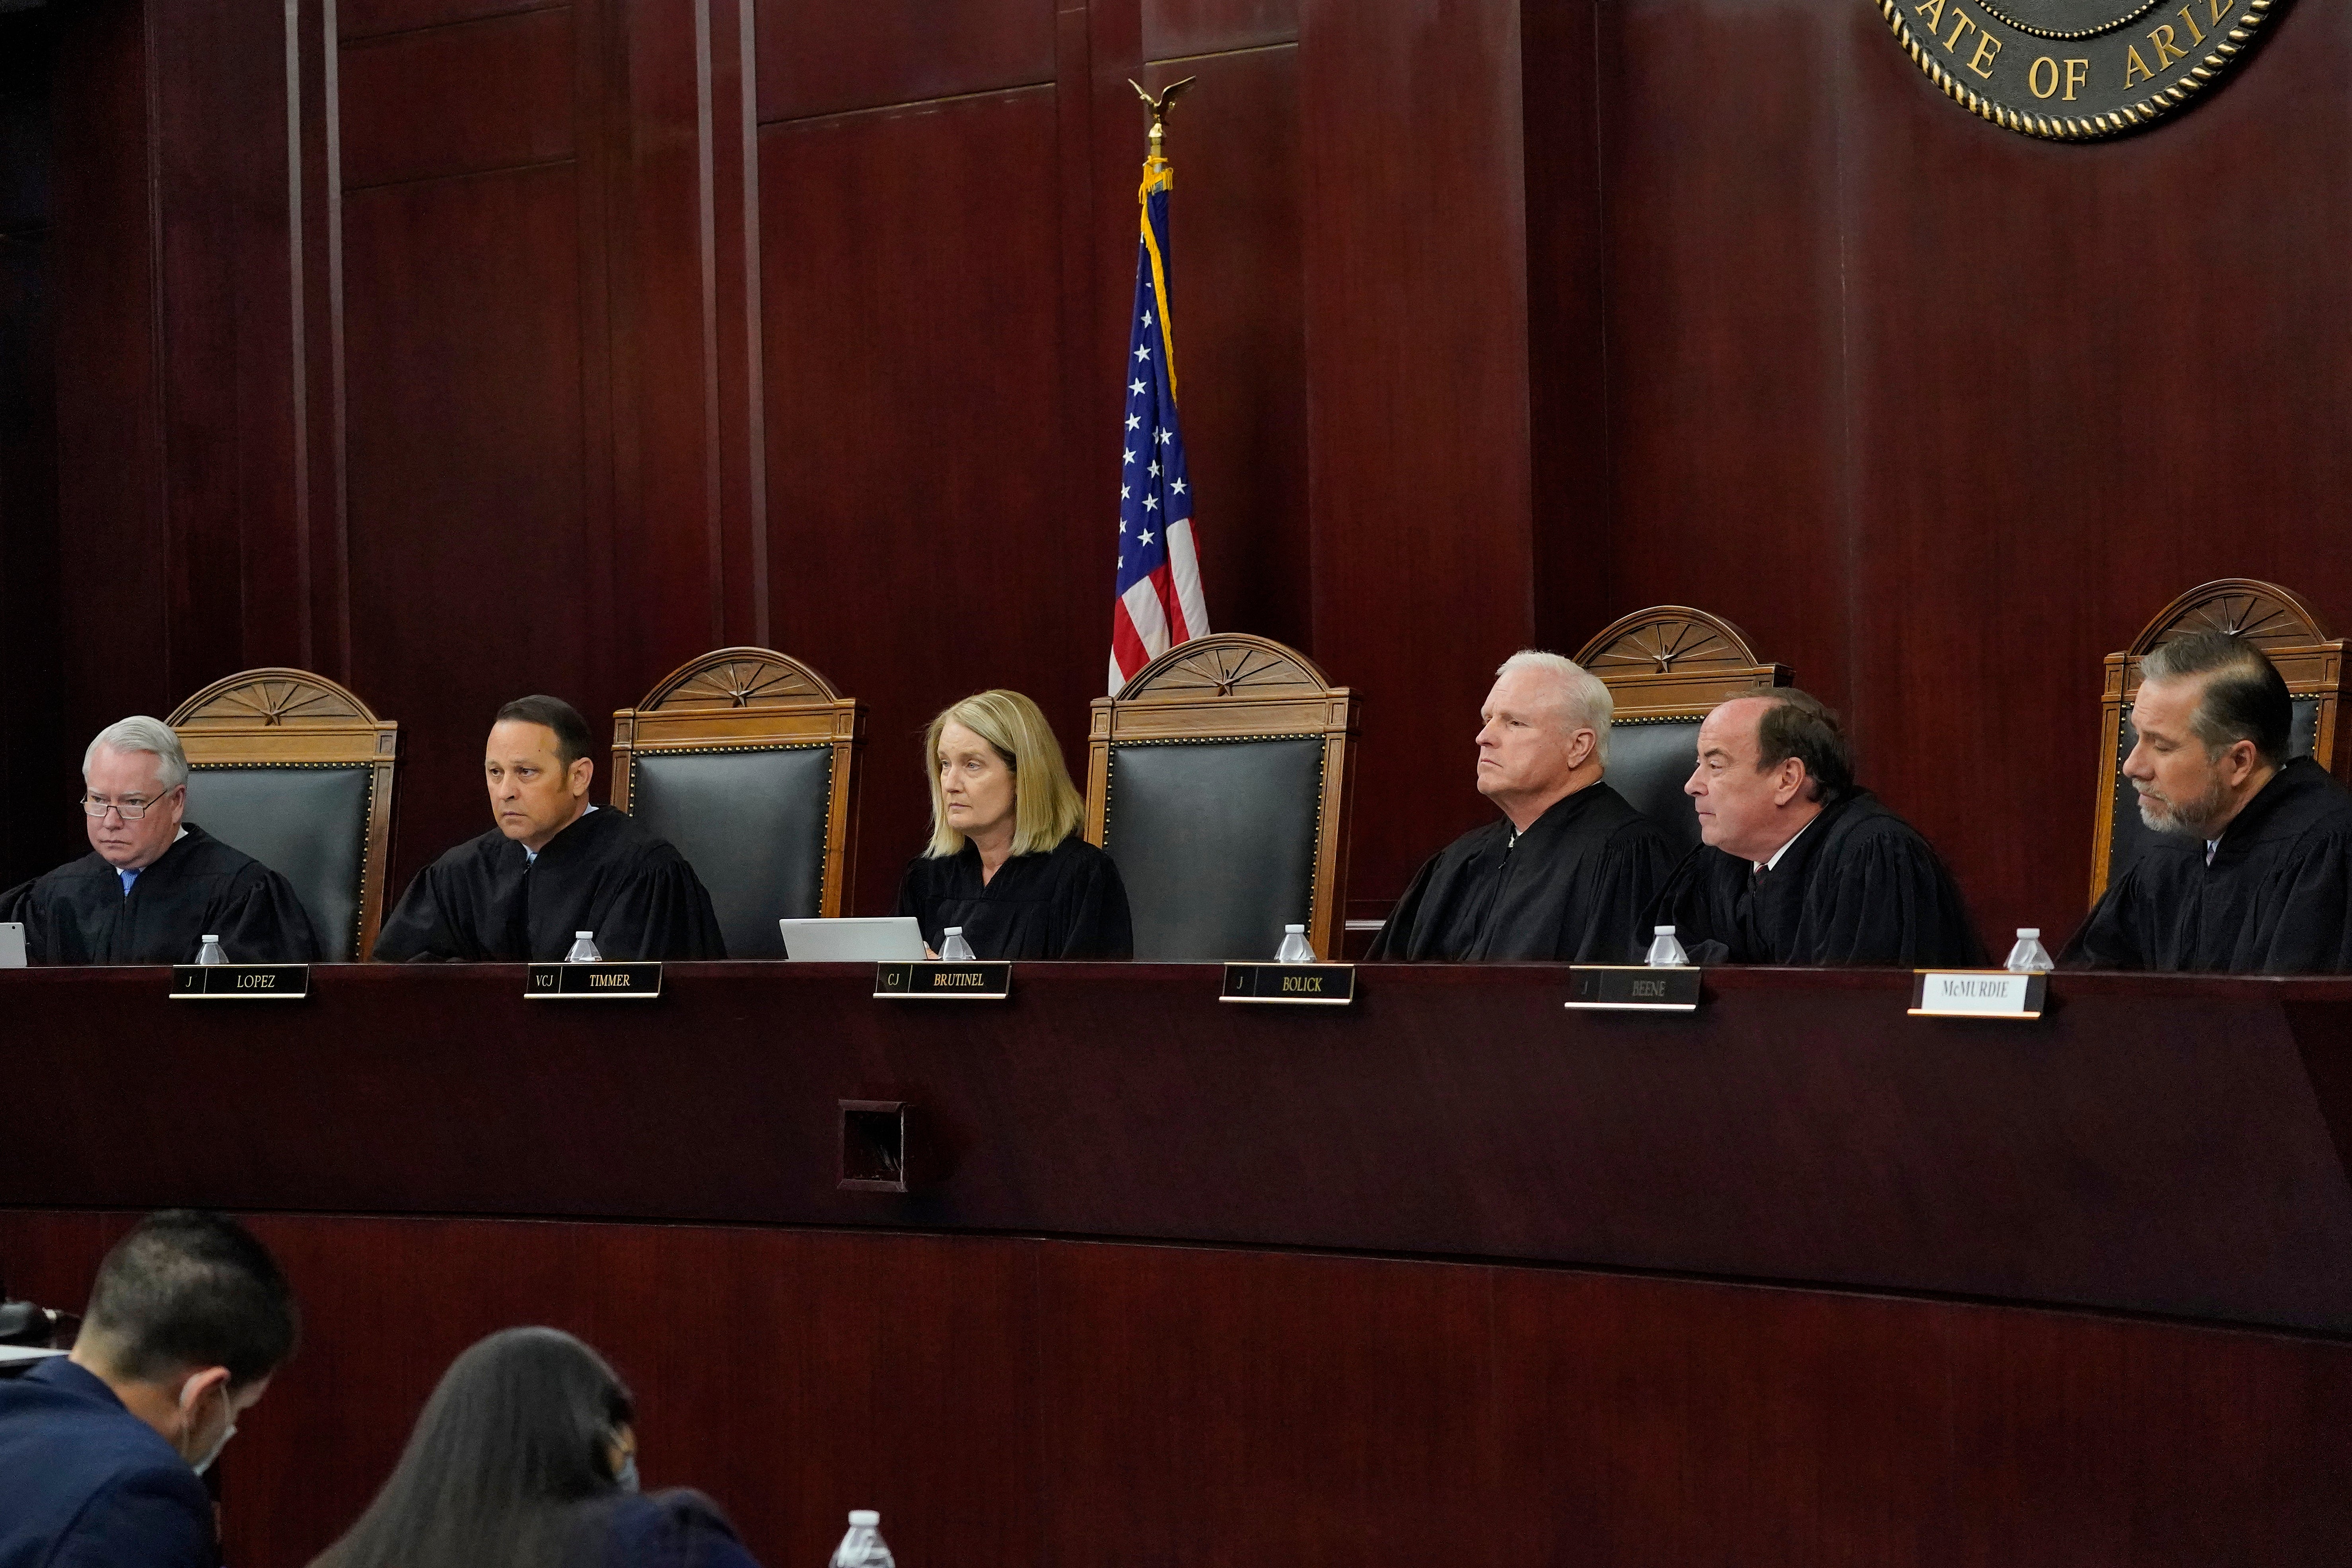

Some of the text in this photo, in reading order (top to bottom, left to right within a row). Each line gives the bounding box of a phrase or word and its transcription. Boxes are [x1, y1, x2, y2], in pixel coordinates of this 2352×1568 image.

[2029, 56, 2088, 101] OF
[185, 975, 275, 988] J LOPEZ
[536, 975, 630, 986] VCJ TIMMER
[888, 973, 984, 986] CJ BRUTINEL
[1237, 977, 1323, 992] J BOLICK
[1632, 980, 1666, 996] BEENE
[1942, 980, 2009, 998] McMURDIE
